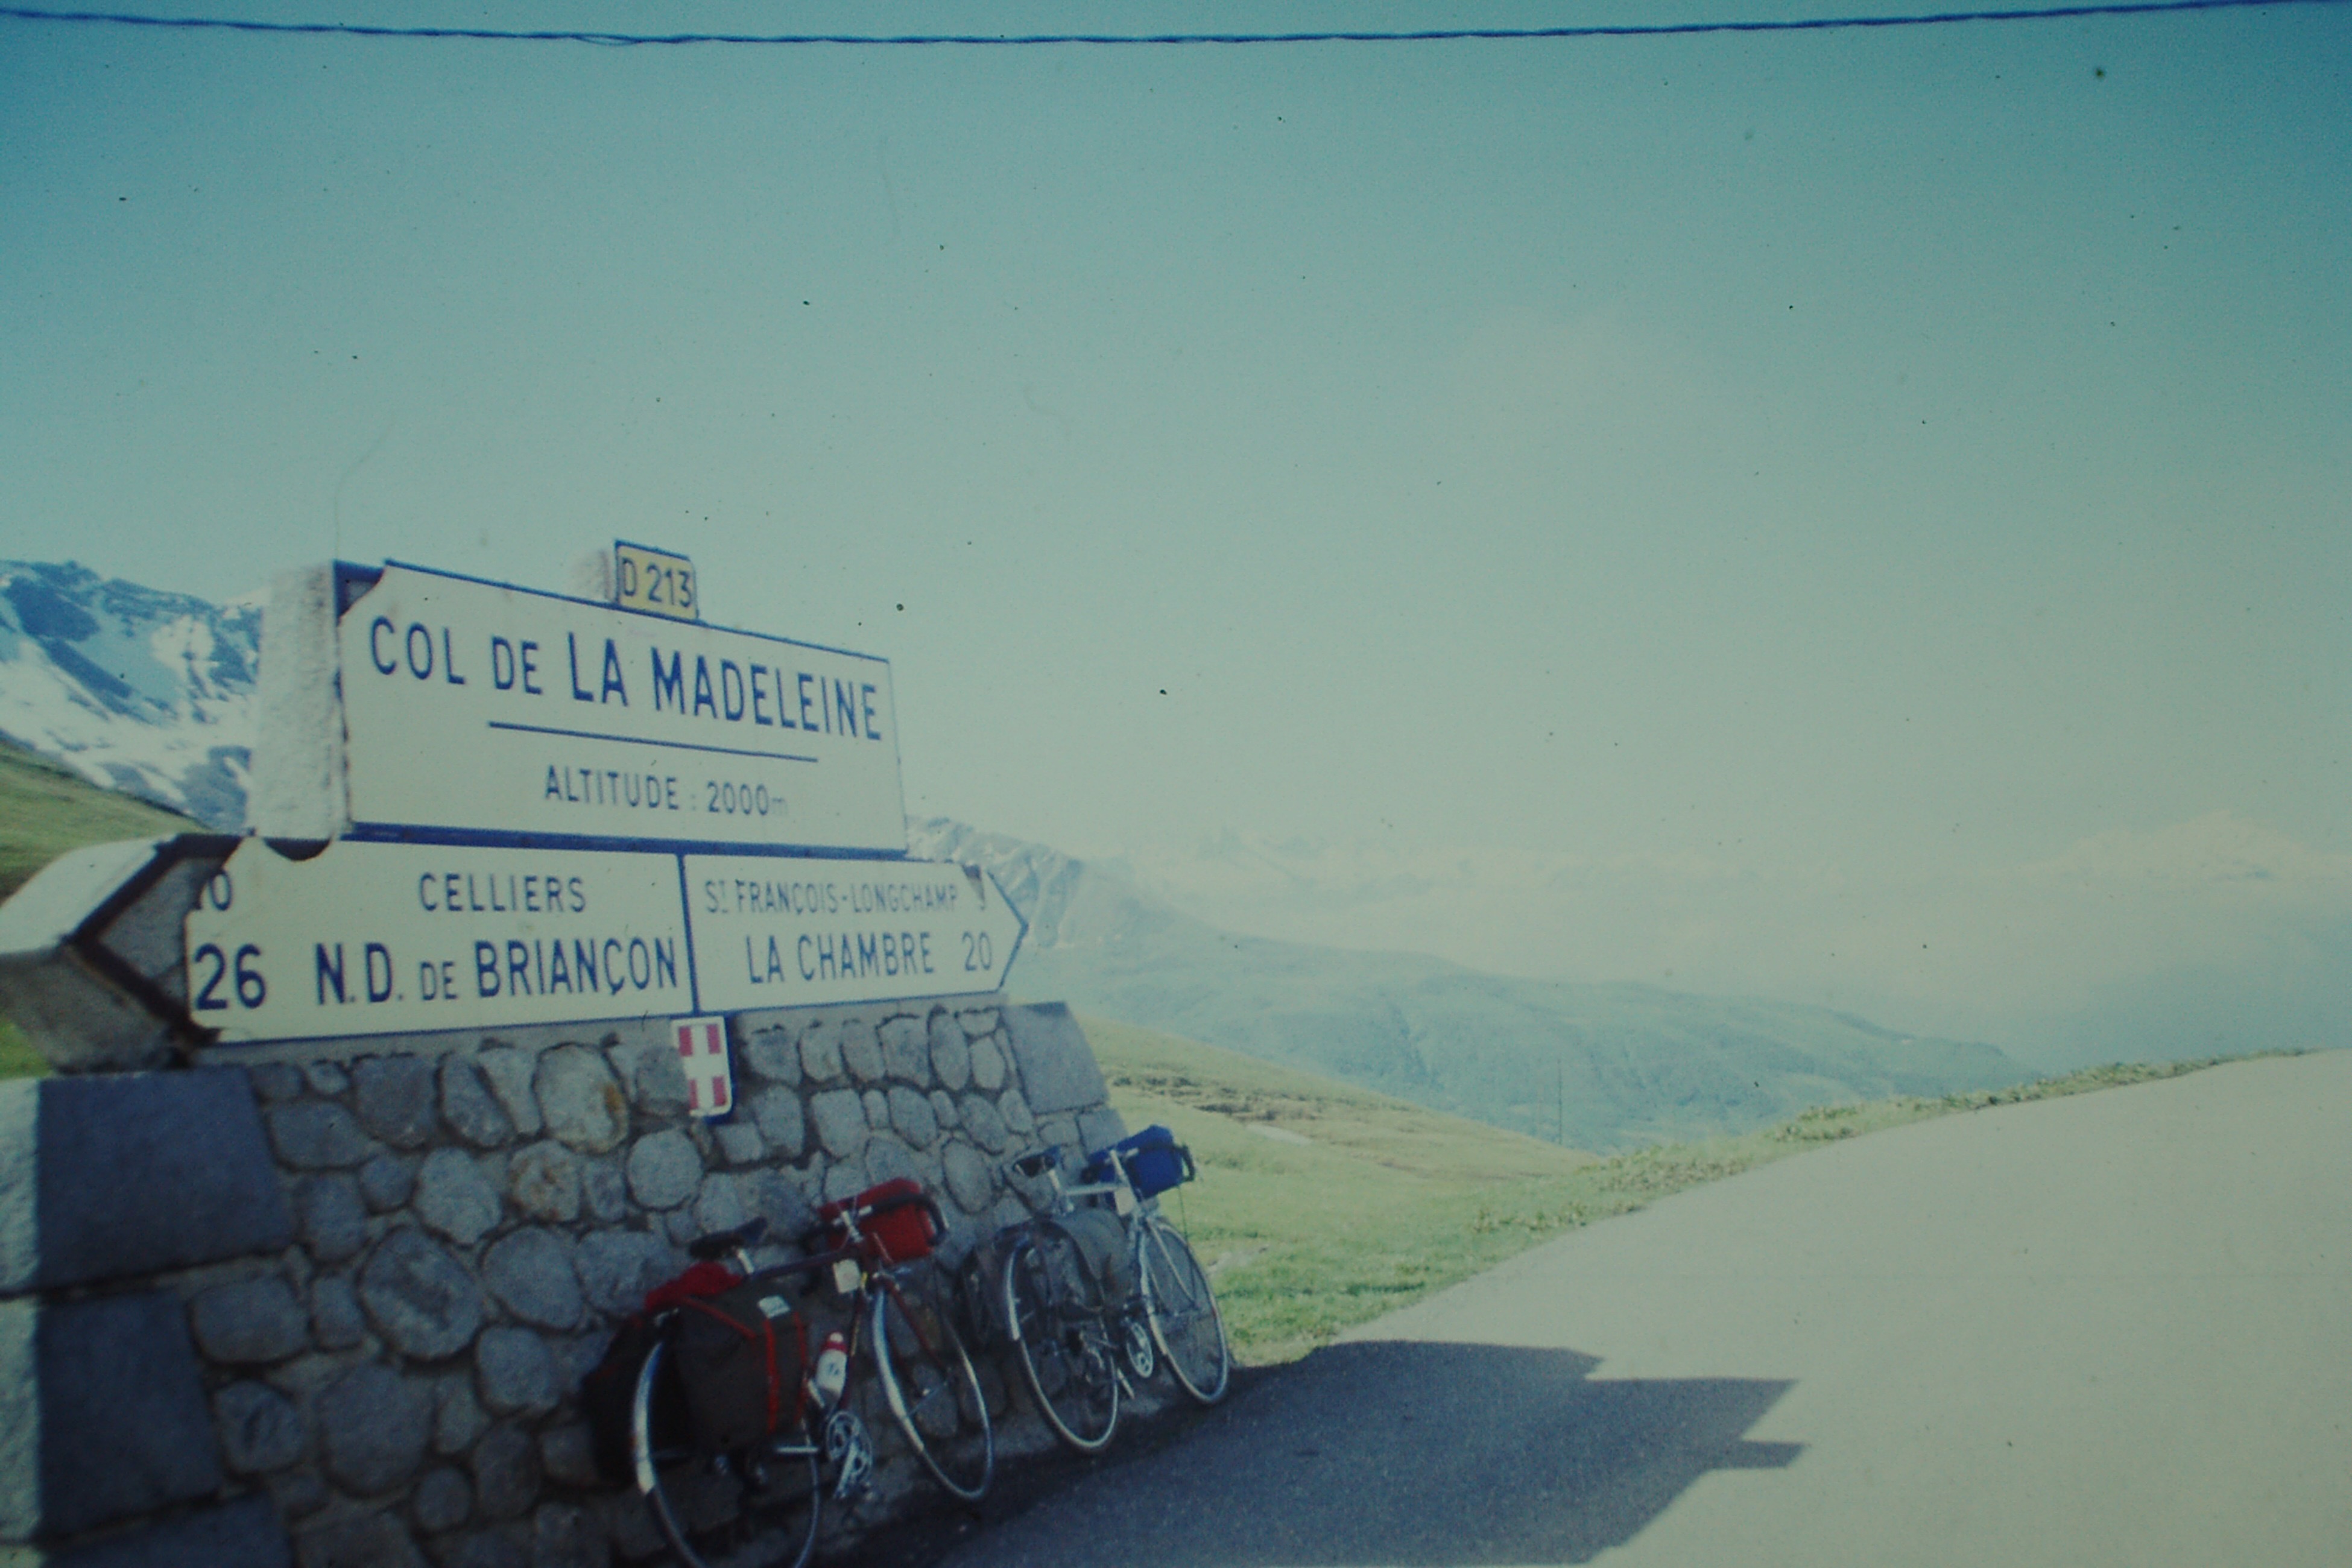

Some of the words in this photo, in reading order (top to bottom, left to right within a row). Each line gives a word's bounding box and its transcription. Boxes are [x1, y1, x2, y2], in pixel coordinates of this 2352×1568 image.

[622, 557, 637, 596] D
[646, 563, 692, 608] 213
[367, 614, 466, 686] COL
[489, 633, 543, 696] DE
[566, 630, 629, 707] LA
[651, 646, 882, 742] MADELEINE
[544, 764, 679, 811] ALTITUDE
[419, 872, 586, 913] CELLIERS
[734, 878, 957, 916] FRANÇOIS-LONGCHAMP
[194, 943, 267, 1010] 26
[417, 961, 459, 1002] DE
[472, 936, 677, 999] BRIANÇON
[745, 935, 785, 985] LA
[796, 931, 934, 982] CHAMBRE
[962, 931, 993, 973] 20
